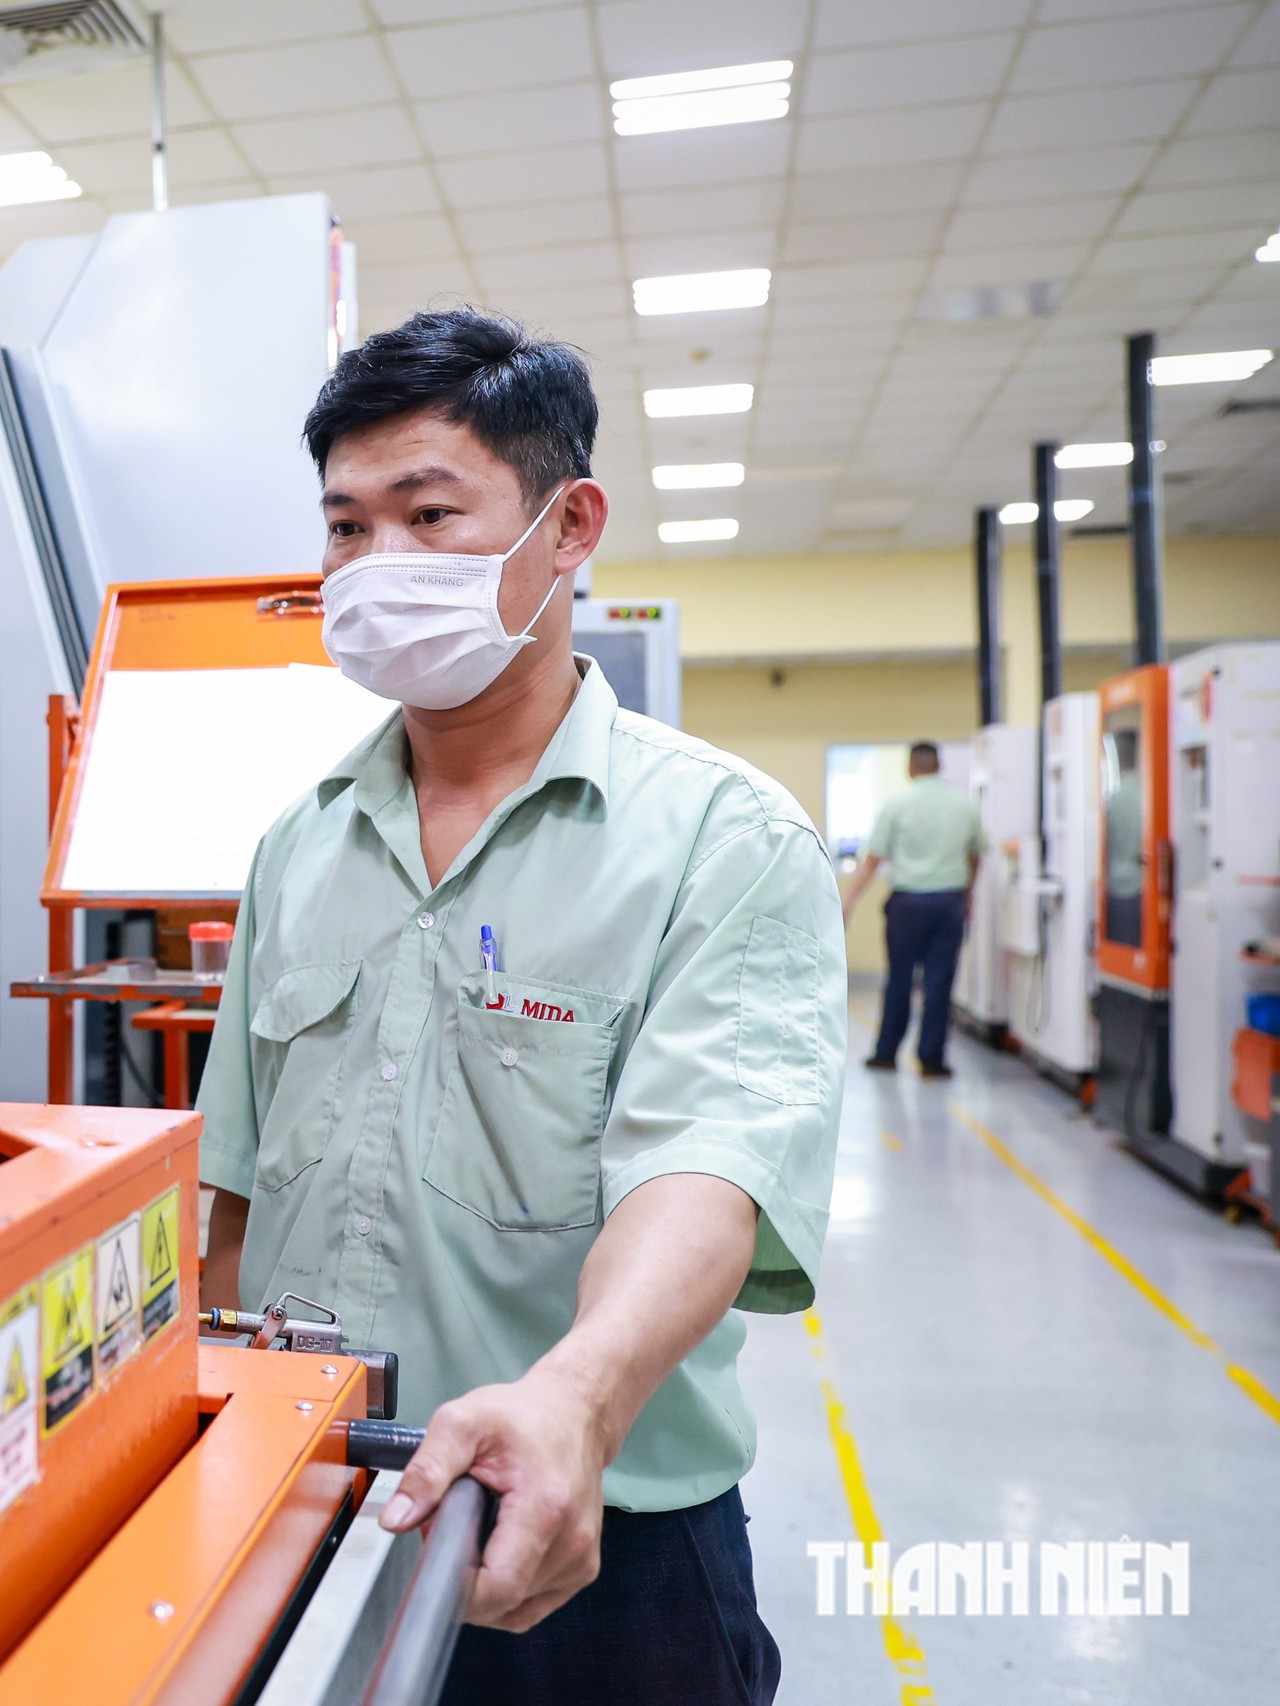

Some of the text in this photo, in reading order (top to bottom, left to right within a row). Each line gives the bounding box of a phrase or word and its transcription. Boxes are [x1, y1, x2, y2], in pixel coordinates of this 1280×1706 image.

[410, 575, 464, 587] AN KHANG
[520, 998, 576, 1023] MIDA
